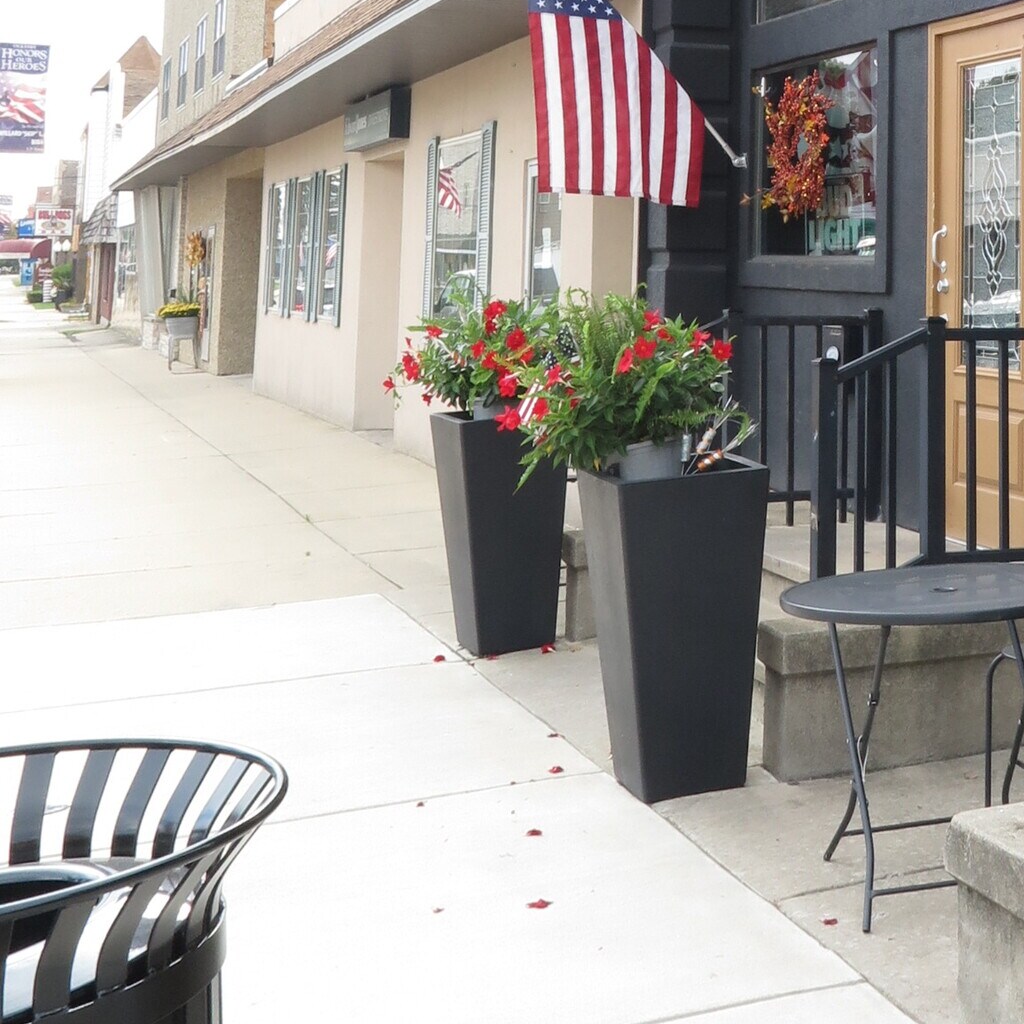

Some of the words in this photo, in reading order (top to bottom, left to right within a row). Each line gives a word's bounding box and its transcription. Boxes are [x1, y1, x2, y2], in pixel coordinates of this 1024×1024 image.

[1, 47, 48, 61] HONORS
[0, 59, 47, 72] HEROES
[808, 218, 862, 251] LIGHT
